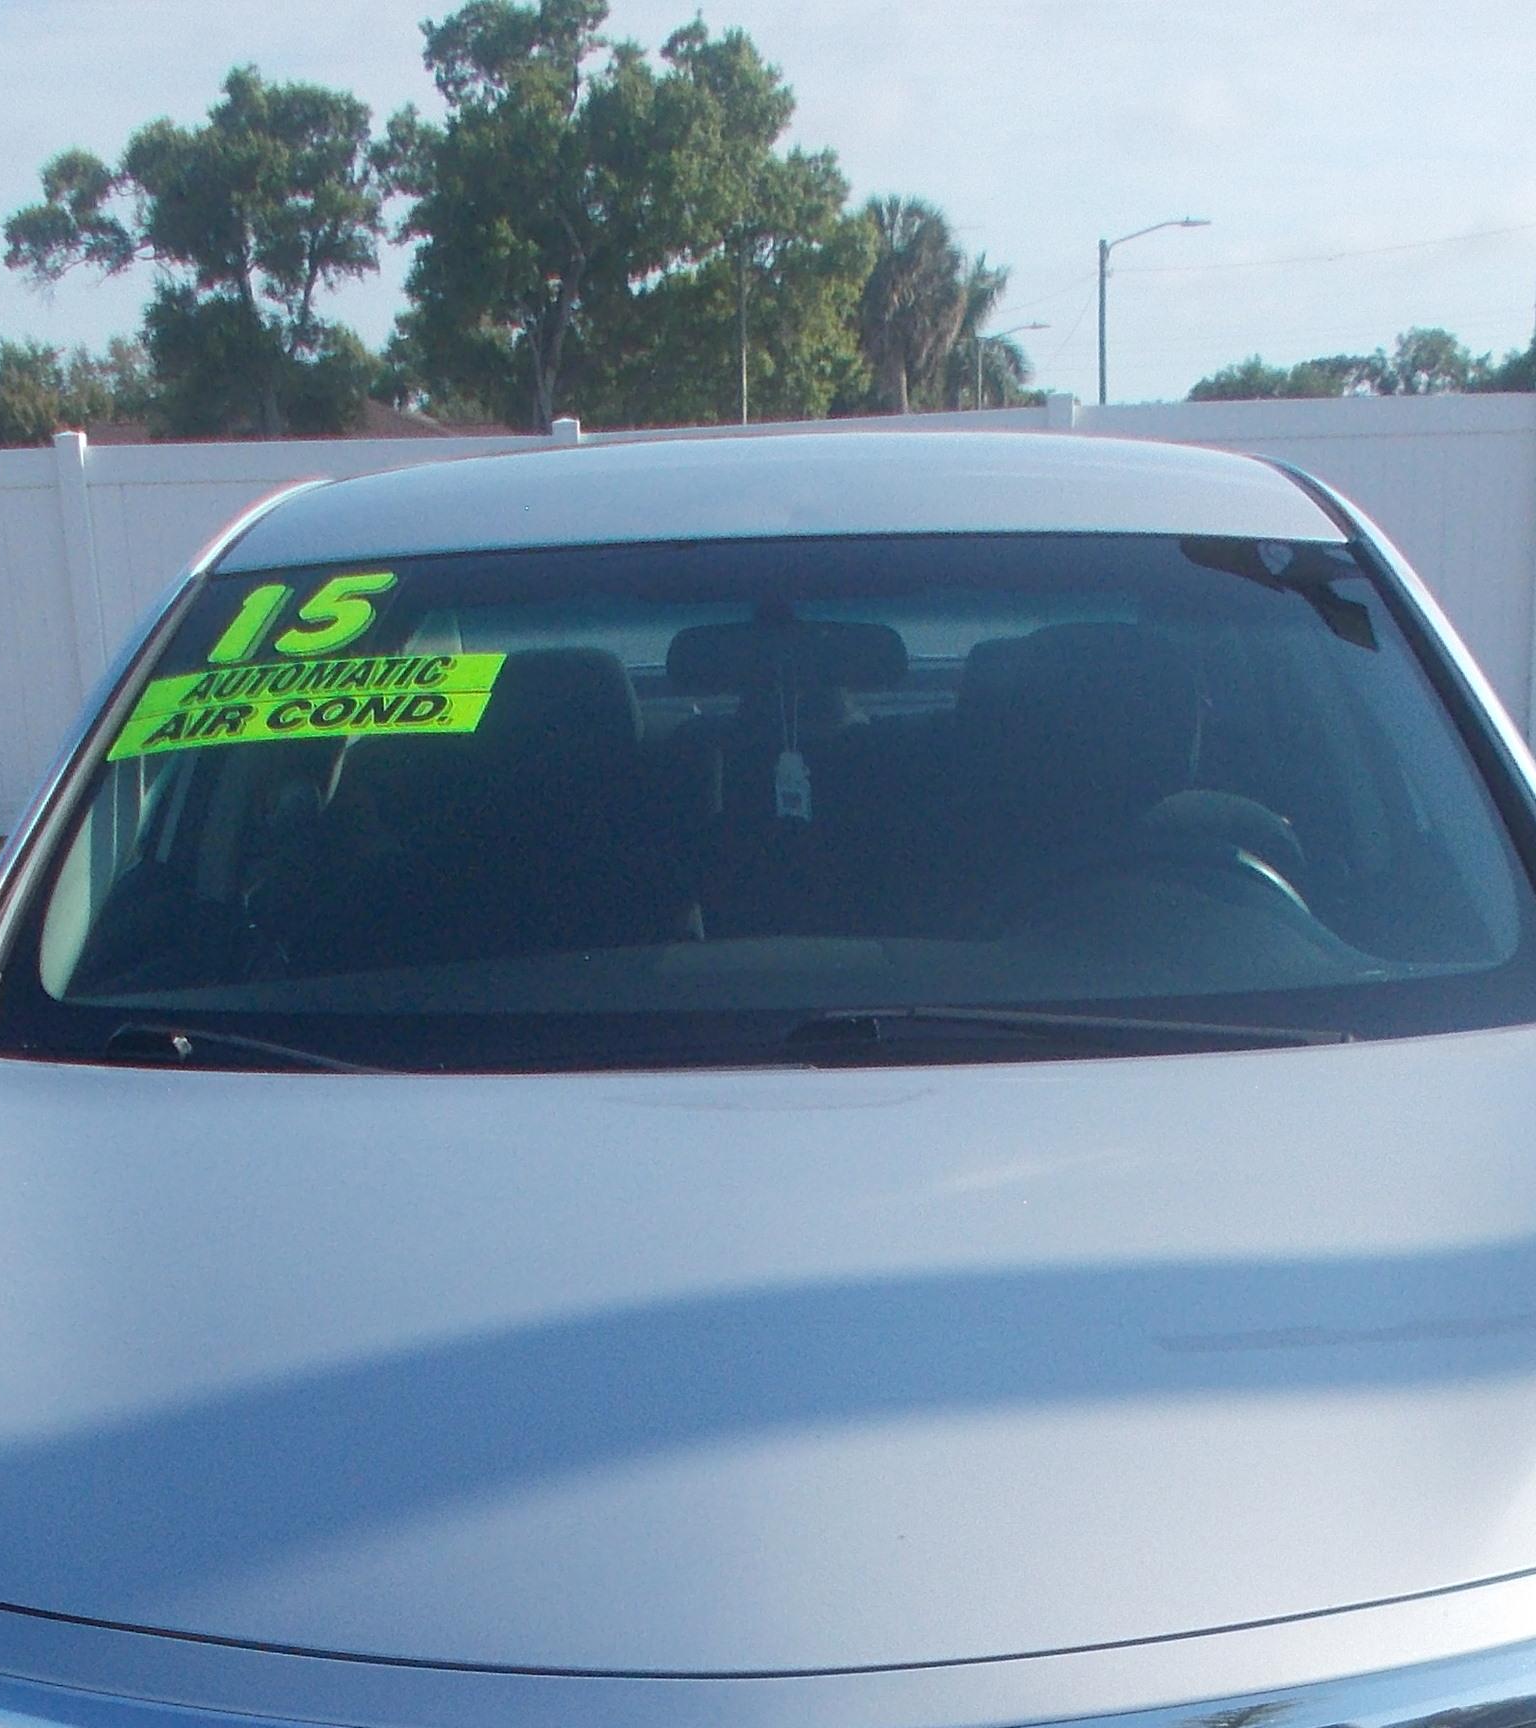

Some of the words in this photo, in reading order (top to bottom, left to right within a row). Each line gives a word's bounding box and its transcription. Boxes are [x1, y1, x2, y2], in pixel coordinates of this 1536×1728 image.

[209, 573, 399, 663] 15
[180, 656, 455, 705] AUTOMATIC
[142, 703, 257, 746] AIR
[265, 694, 454, 731] COND.
